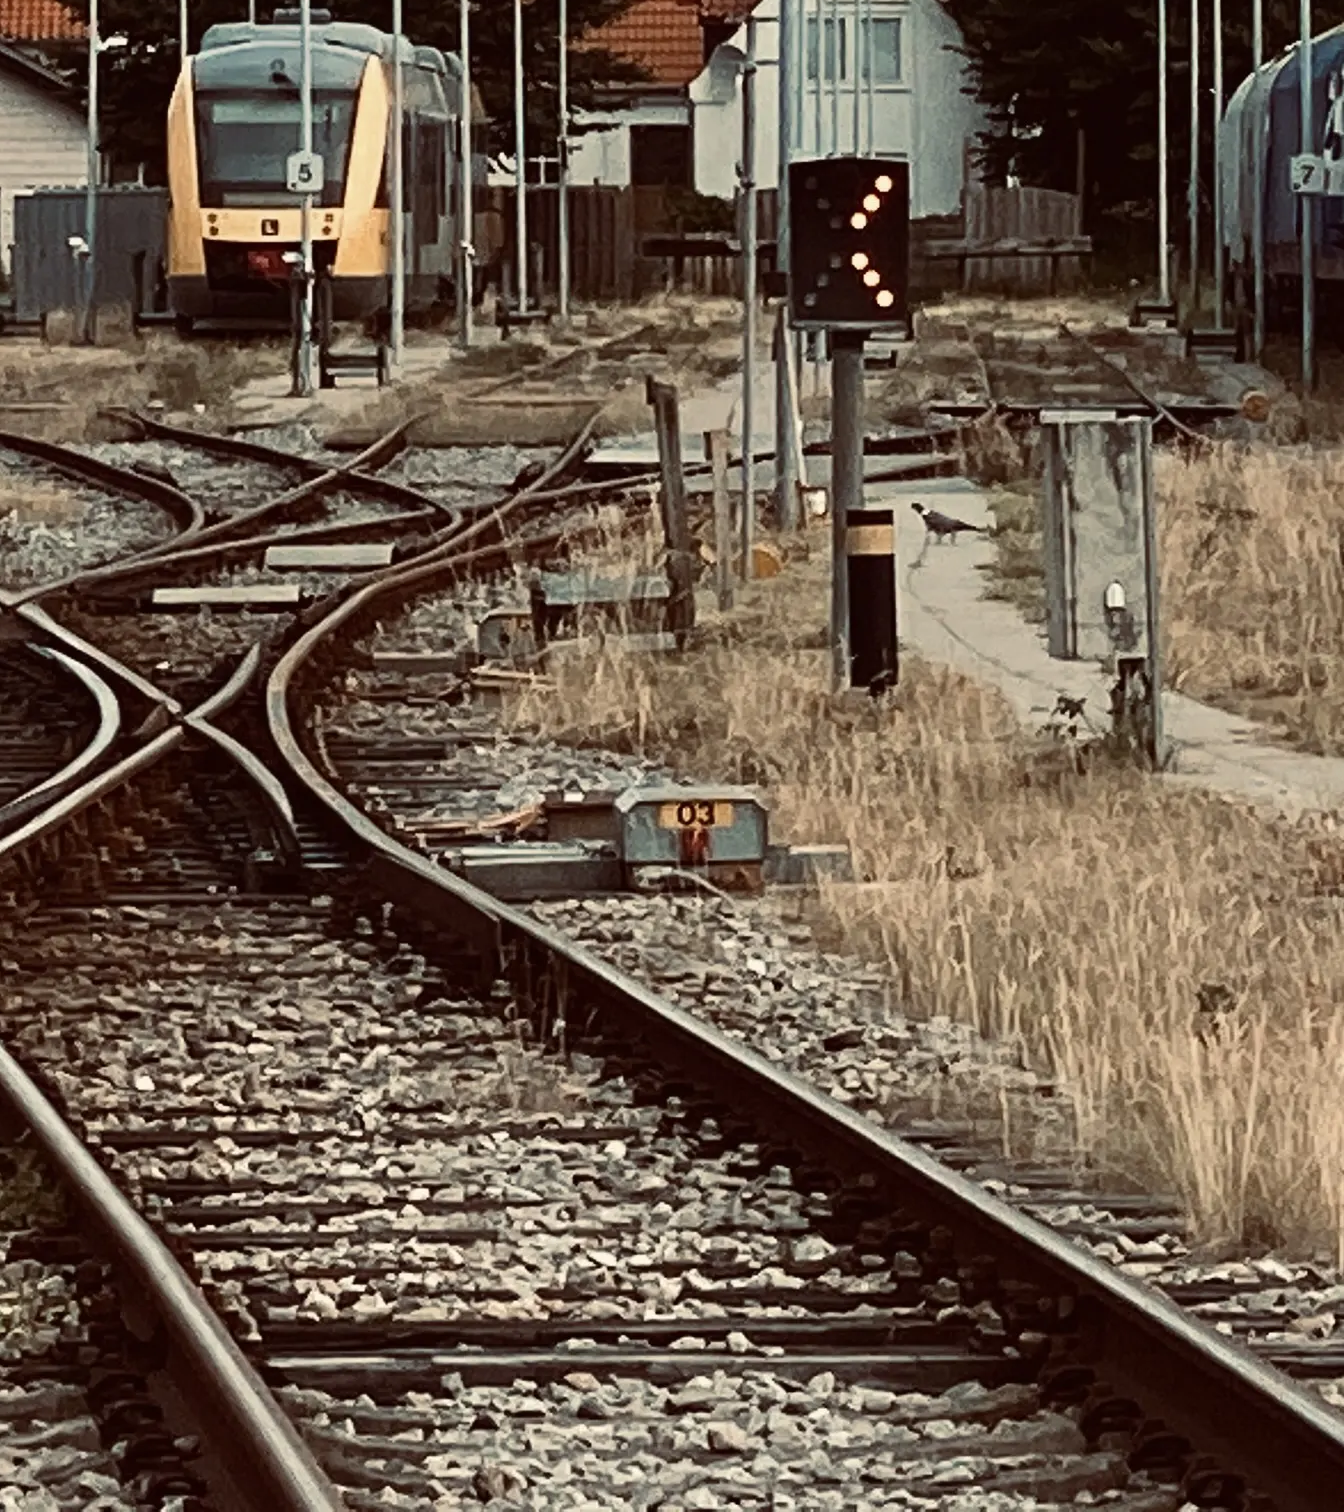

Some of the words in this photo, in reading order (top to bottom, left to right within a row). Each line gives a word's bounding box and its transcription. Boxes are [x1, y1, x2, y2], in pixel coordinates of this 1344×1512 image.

[298, 163, 313, 183] 5
[1300, 164, 1316, 185] 7
[677, 800, 716, 826] 03
